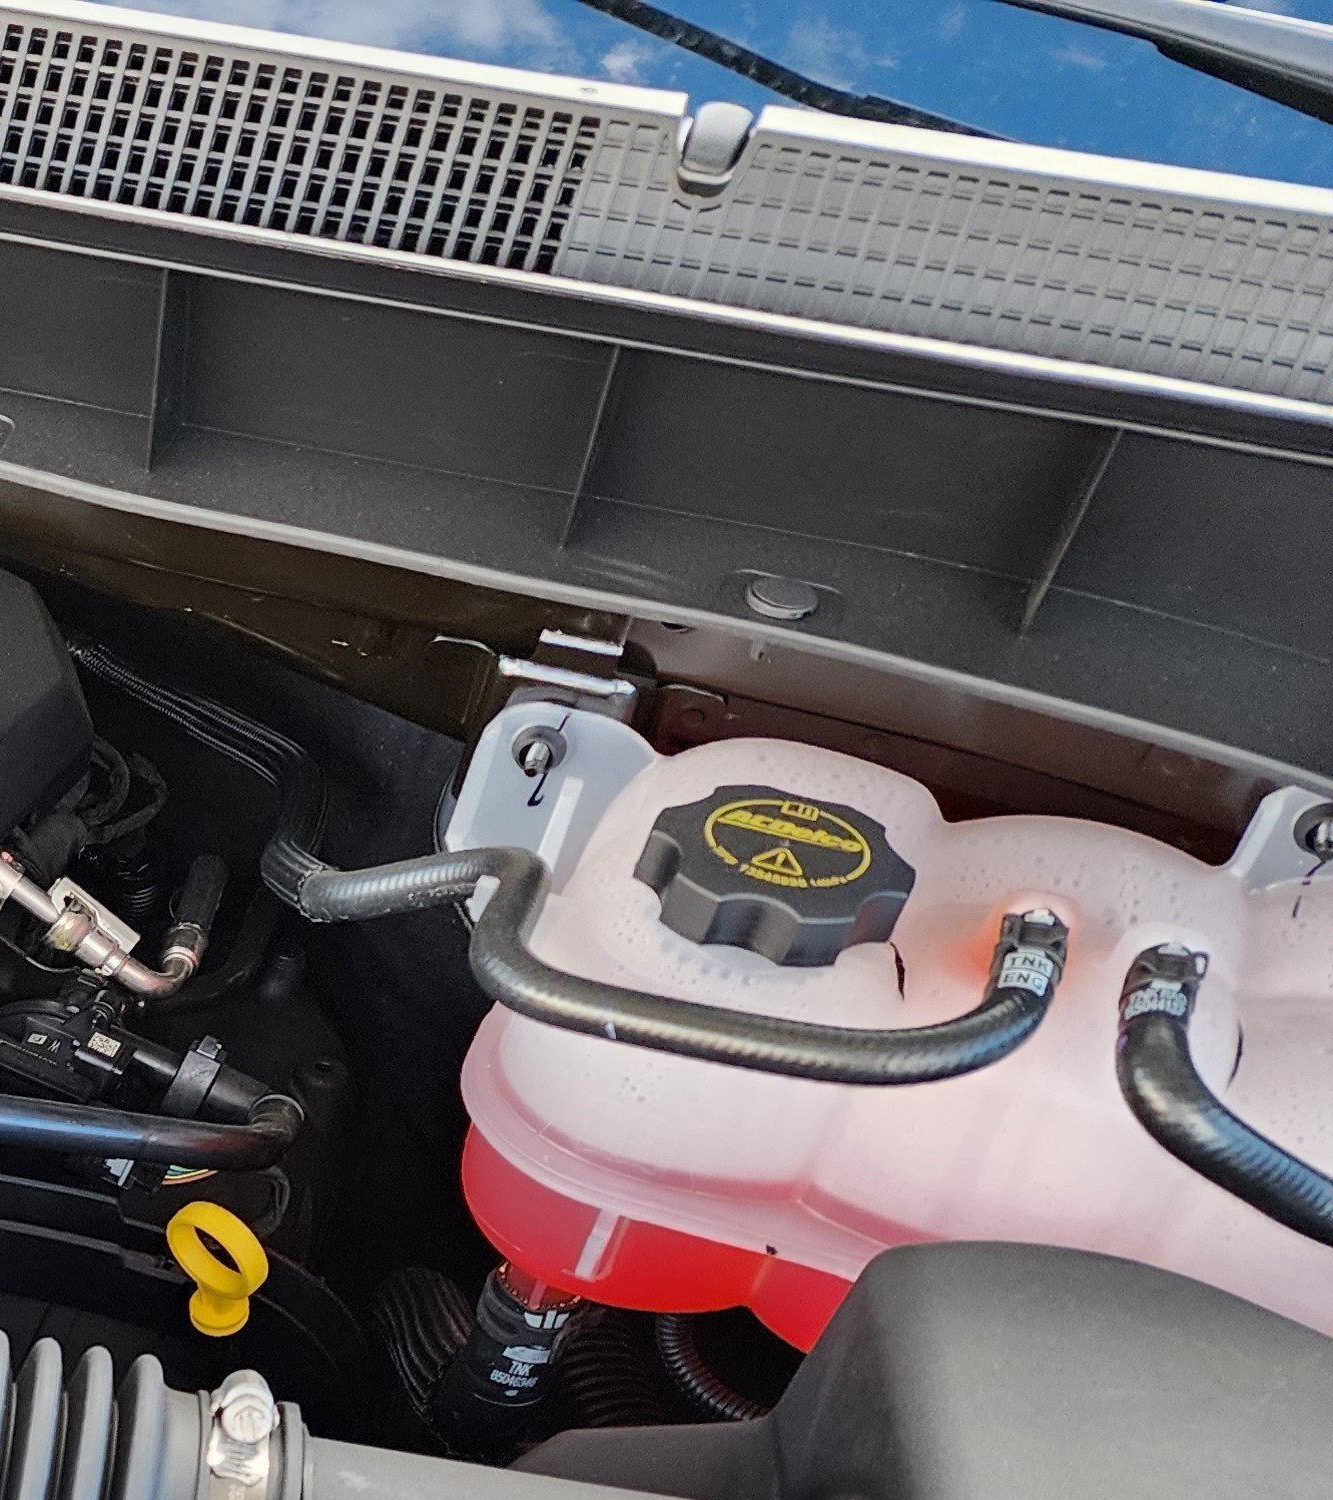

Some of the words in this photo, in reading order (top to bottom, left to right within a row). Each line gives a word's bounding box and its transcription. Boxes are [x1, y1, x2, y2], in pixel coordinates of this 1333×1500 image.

[717, 809, 864, 853] ACDelco
[1006, 955, 1050, 971] TNK
[1002, 972, 1044, 992] ENG
